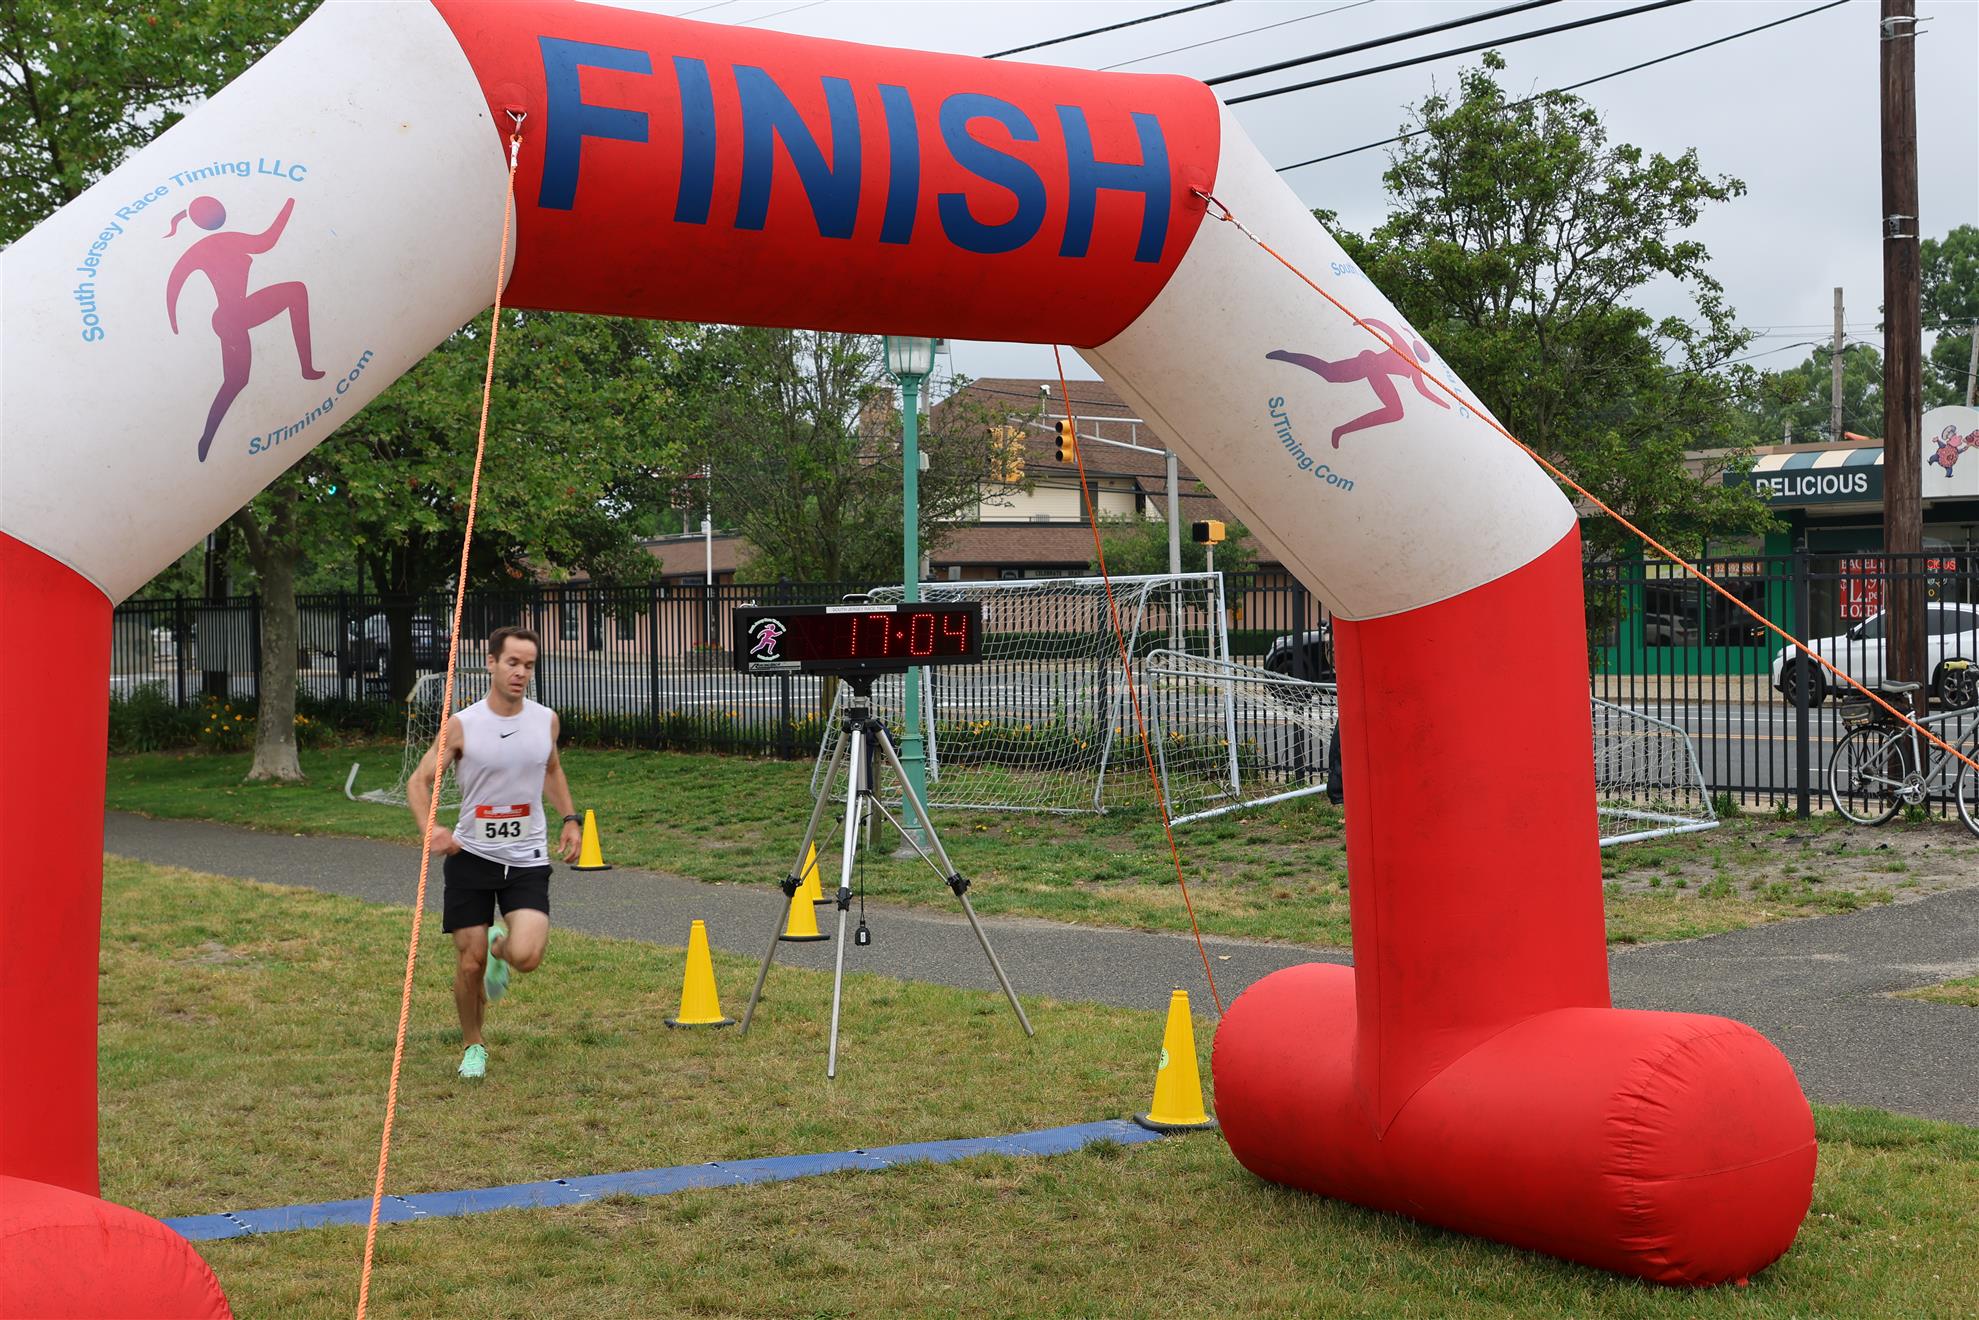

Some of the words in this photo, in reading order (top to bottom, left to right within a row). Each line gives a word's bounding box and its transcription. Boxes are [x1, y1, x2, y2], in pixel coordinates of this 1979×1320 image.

[257, 158, 308, 183] LLC
[538, 35, 1171, 264] FINISH
[169, 160, 251, 188] Timing
[115, 185, 169, 221] Race
[77, 221, 124, 278] Jersey
[73, 282, 105, 342] South
[248, 349, 374, 455] SJTiming.Com
[1268, 396, 1355, 491] SJTiming.Com
[1756, 473, 1868, 497] DELICIOUS
[485, 821, 521, 839] 543
